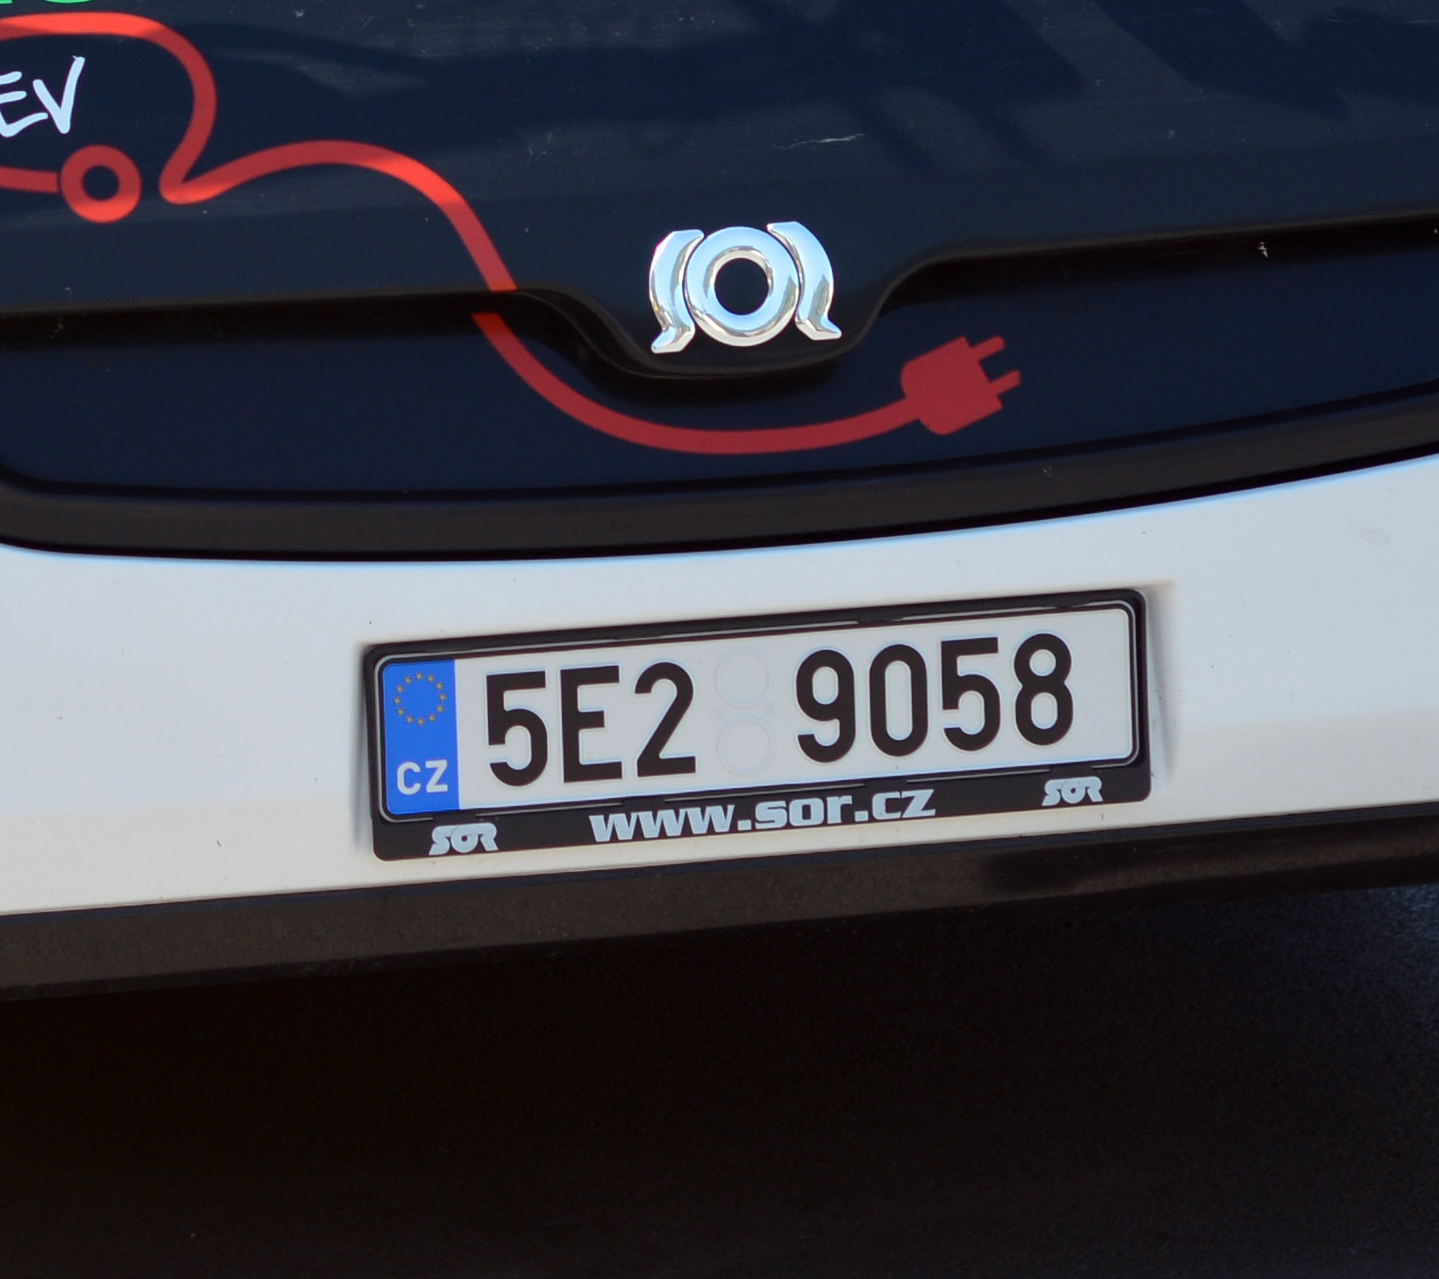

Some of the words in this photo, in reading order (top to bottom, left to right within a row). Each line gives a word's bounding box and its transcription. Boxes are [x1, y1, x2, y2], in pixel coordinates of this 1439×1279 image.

[395, 759, 449, 796] CZ
[484, 661, 697, 788] 5E2
[794, 632, 1075, 763] 9058
[1041, 775, 1104, 807] SOR
[587, 788, 937, 843] www.sor.cz
[427, 821, 499, 856] SOR
